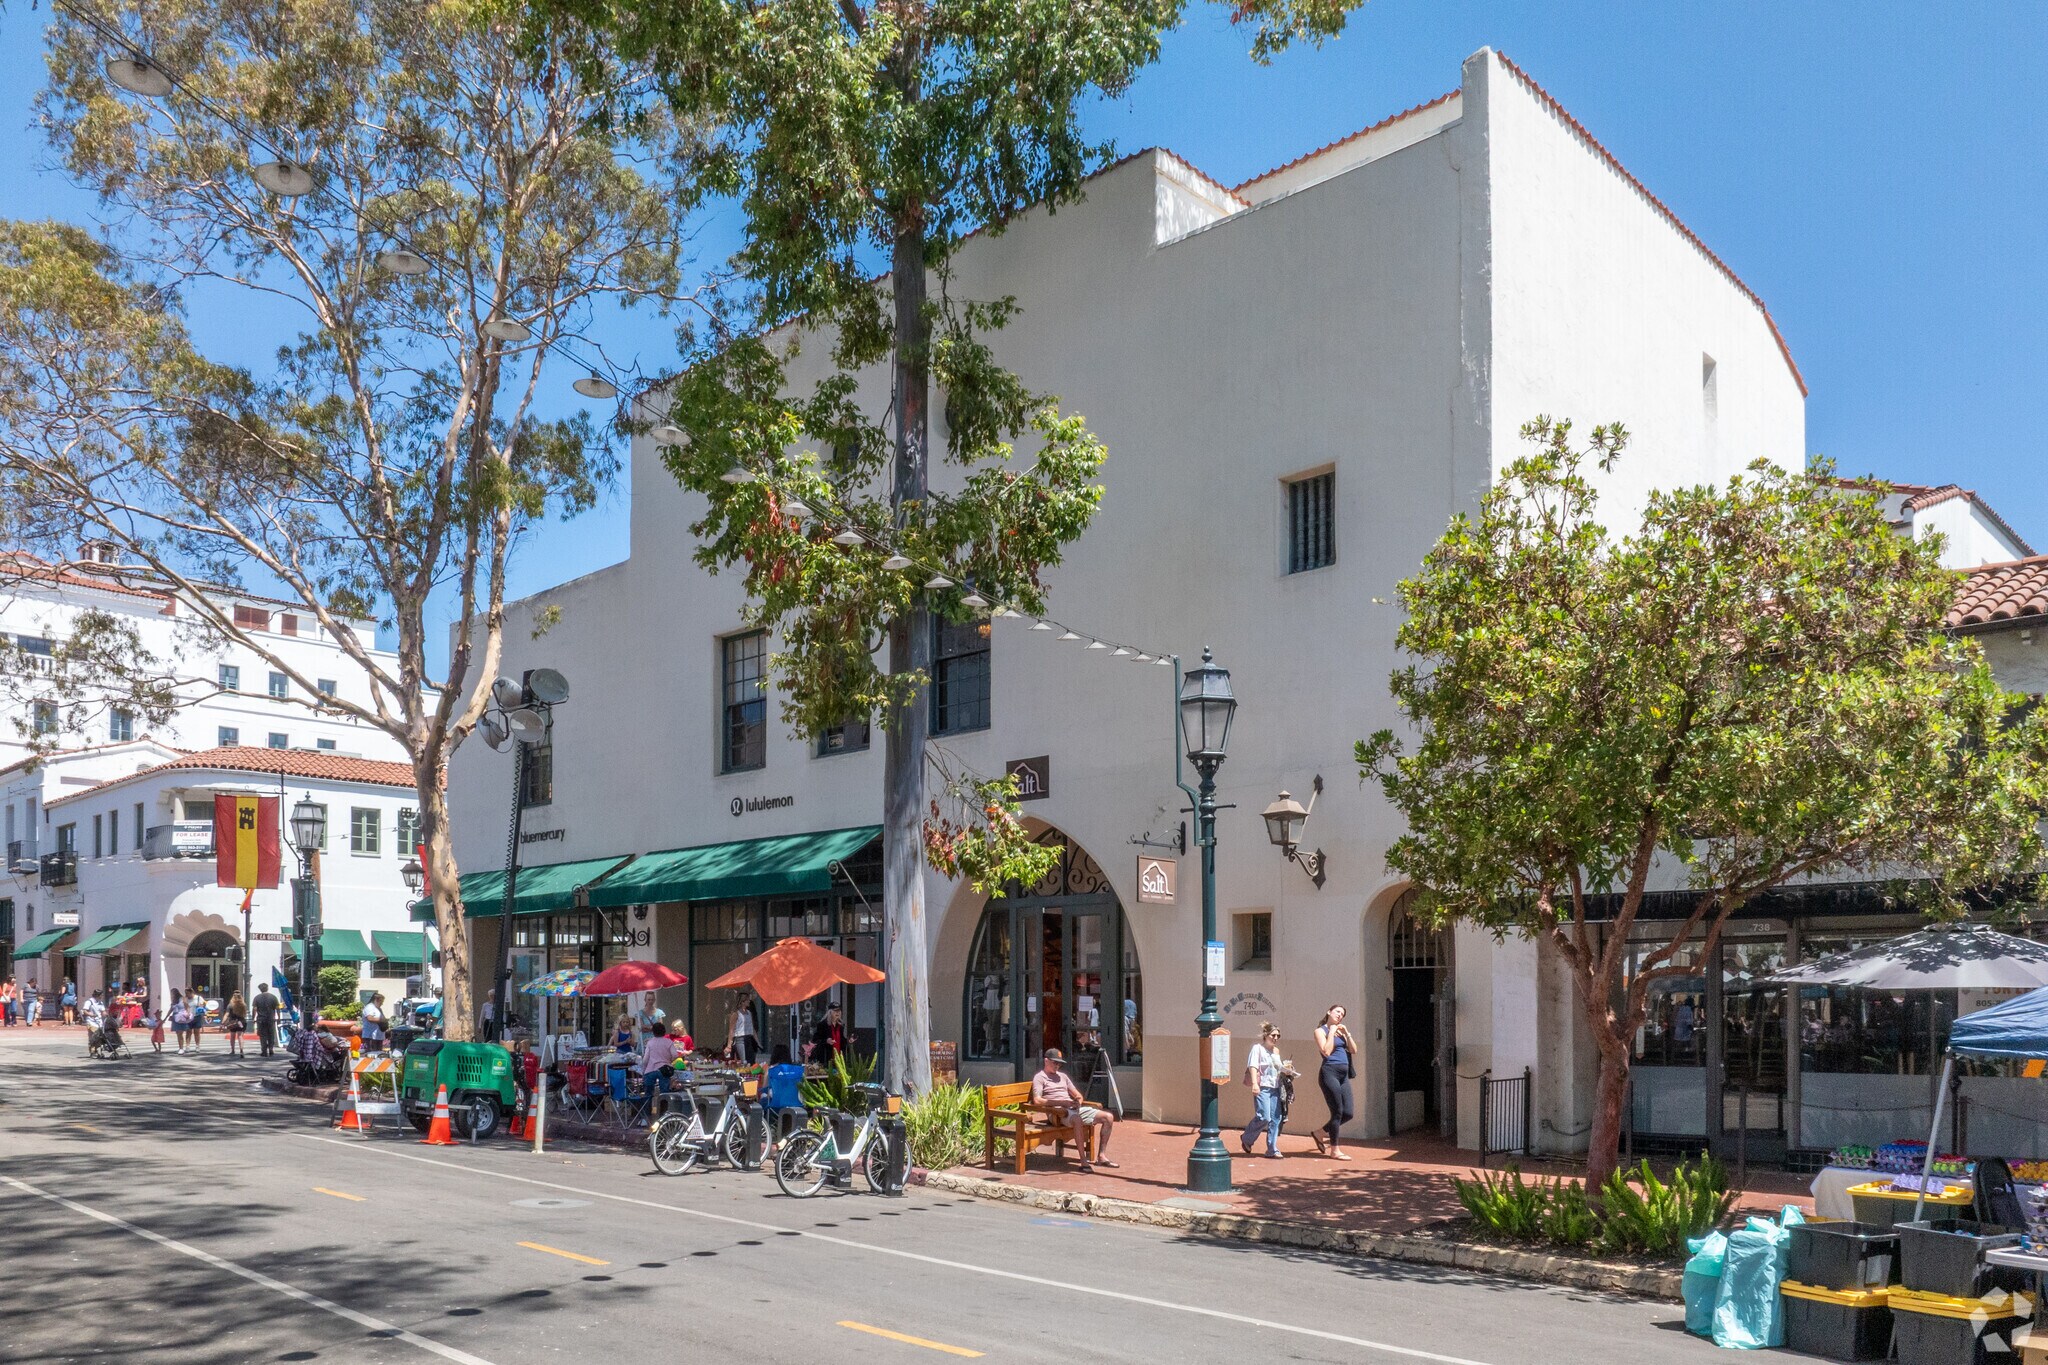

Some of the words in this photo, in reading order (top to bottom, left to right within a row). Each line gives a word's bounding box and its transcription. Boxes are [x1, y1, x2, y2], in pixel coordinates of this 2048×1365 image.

[1016, 774, 1036, 794] alt
[745, 796, 793, 812] lululemon
[520, 829, 565, 844] bluemercury
[1142, 874, 1165, 893] Salt
[1752, 923, 1771, 932] 738
[1243, 1001, 1258, 1010] 740
